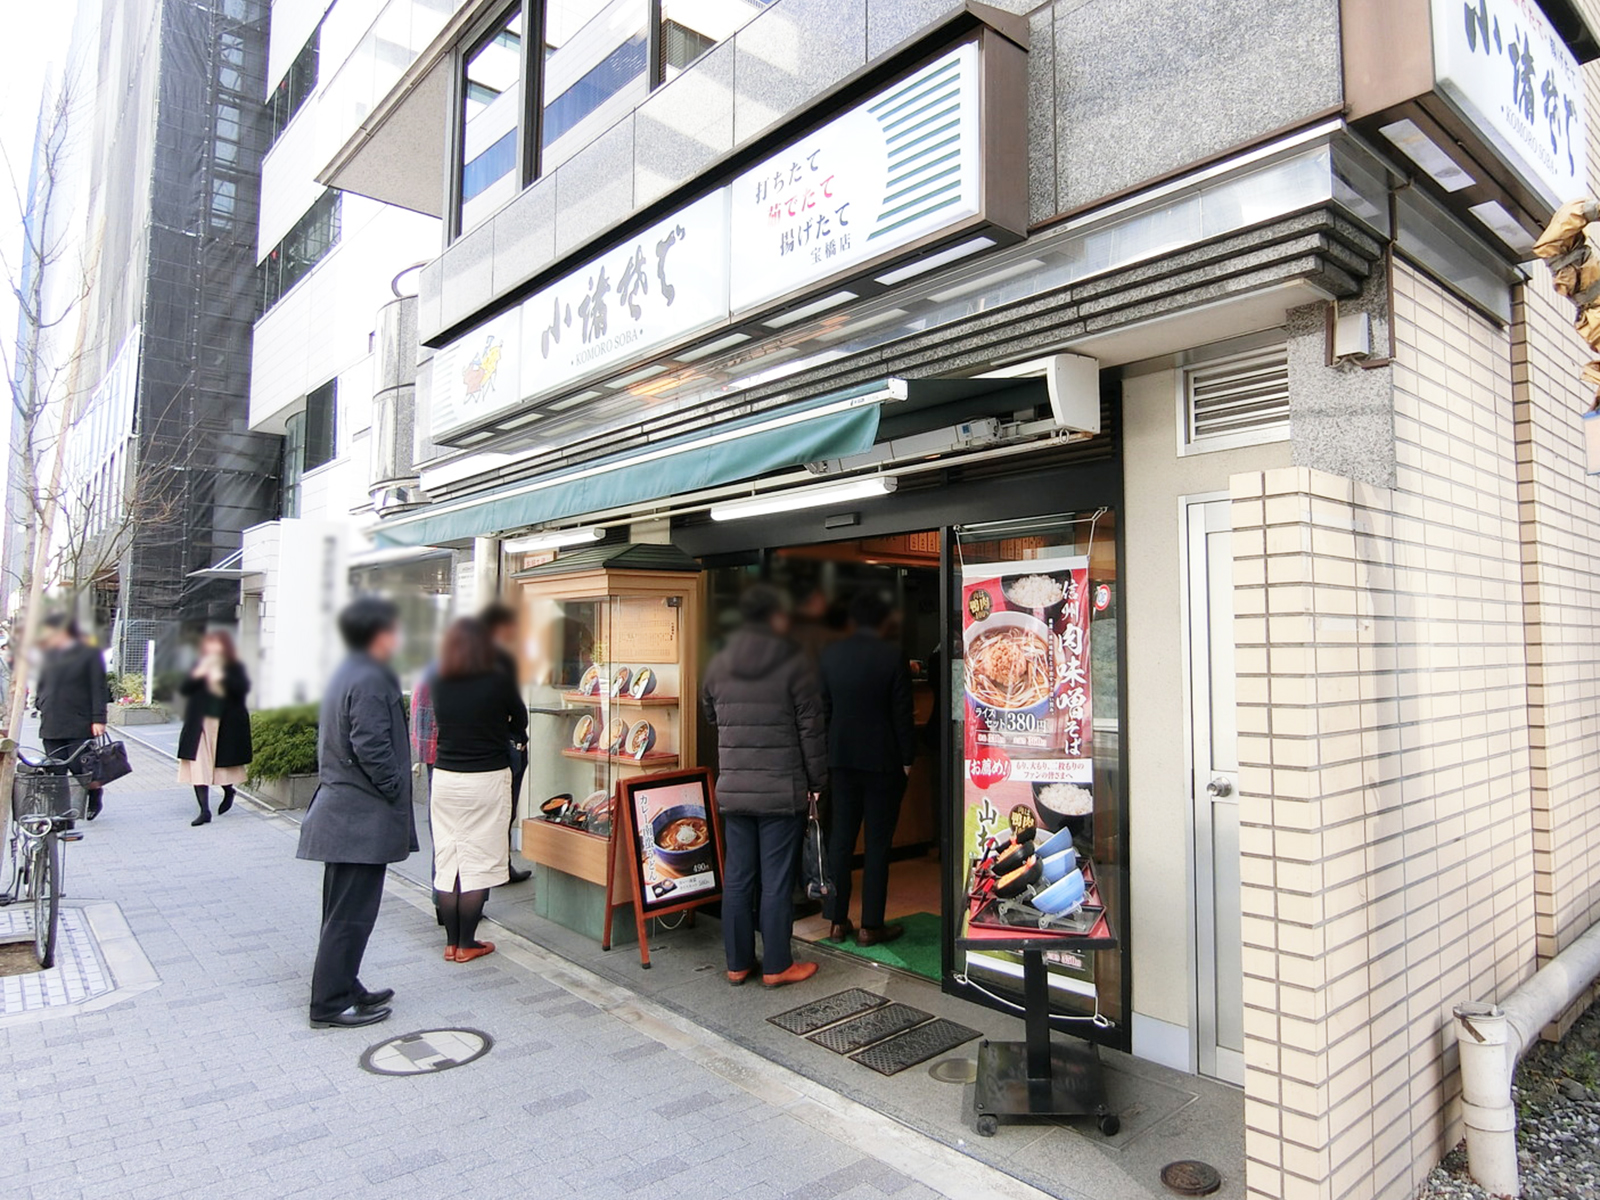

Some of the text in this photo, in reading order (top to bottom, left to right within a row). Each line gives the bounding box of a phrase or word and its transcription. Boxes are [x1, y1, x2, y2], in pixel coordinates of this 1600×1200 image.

[756, 148, 821, 205] 打ちたて
[780, 202, 850, 257] 揚げたて
[575, 328, 638, 367] KOMORO SOBA
[1056, 579, 1087, 756] 信州肉味噌そば
[975, 707, 996, 718] ライス
[984, 712, 1047, 733] セット 380円
[1011, 812, 1035, 829] 鴨肉
